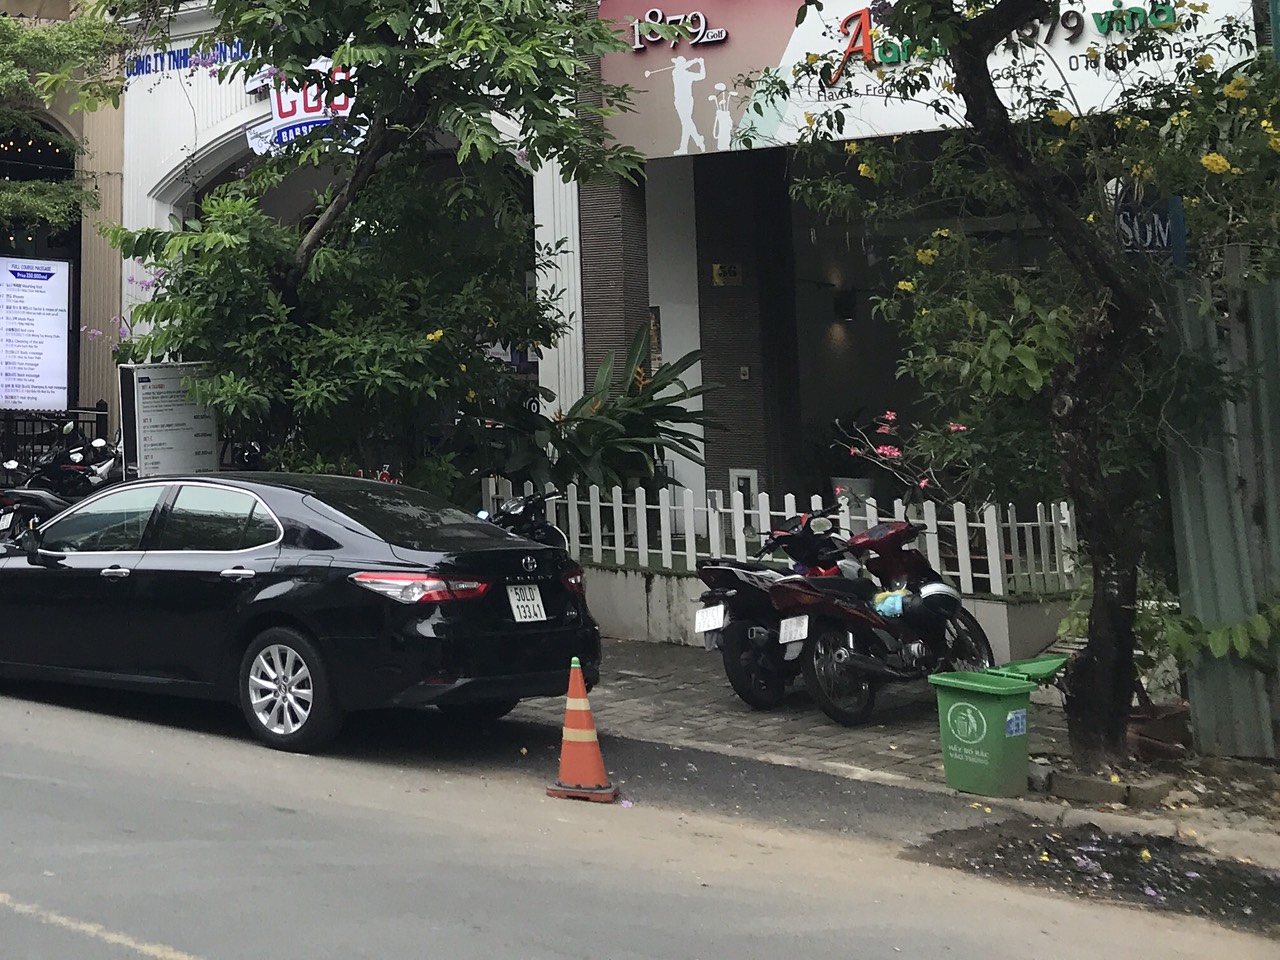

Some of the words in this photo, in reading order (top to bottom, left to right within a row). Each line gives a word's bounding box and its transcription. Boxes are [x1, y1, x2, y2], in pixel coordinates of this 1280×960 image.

[630, 8, 707, 50] 1879
[706, 29, 725, 41] Golf
[153, 50, 166, 72] TY
[514, 586, 536, 602] 50LD
[516, 603, 544, 620] 133.41
